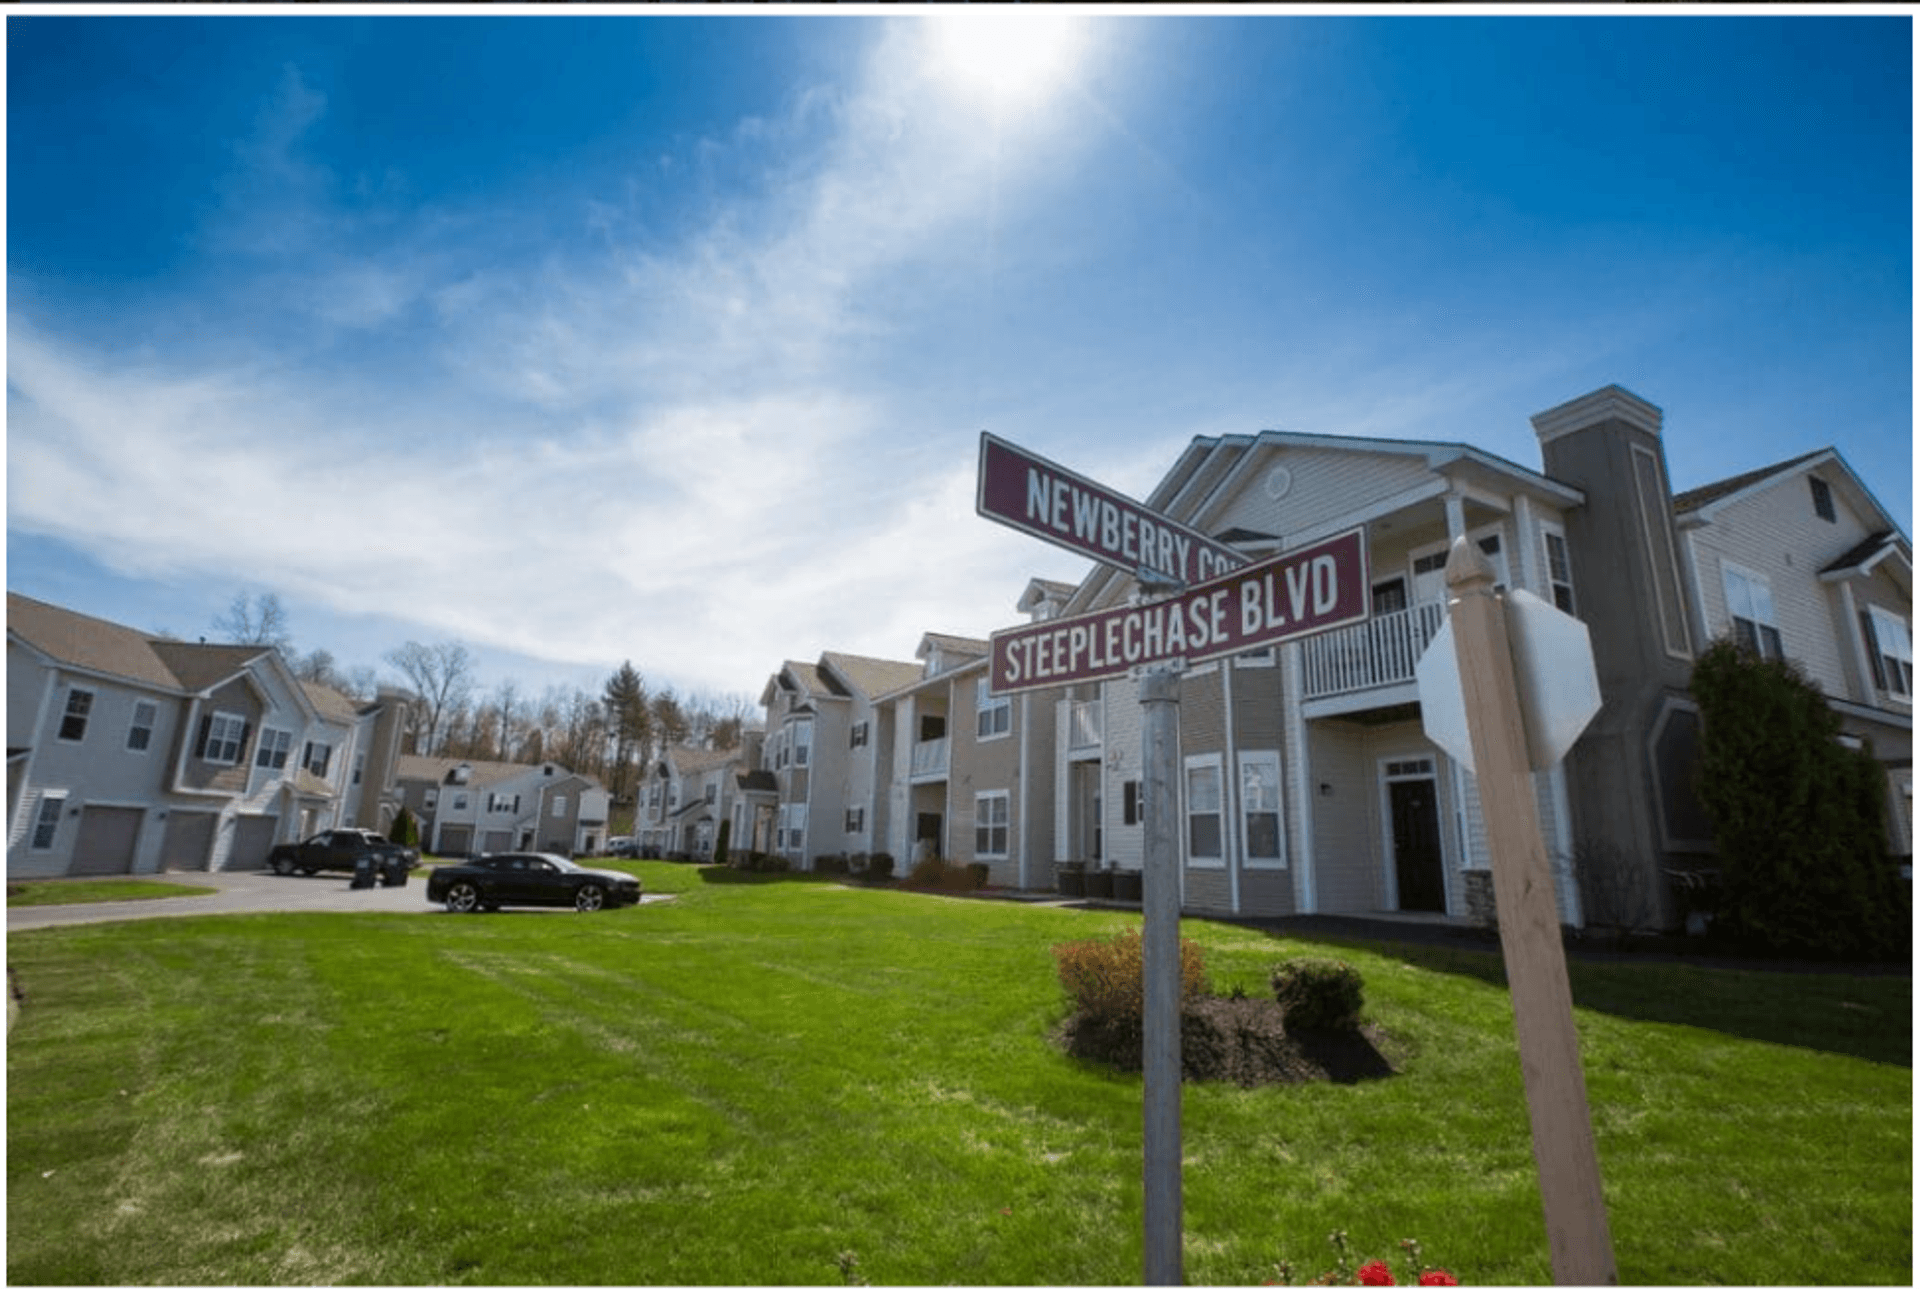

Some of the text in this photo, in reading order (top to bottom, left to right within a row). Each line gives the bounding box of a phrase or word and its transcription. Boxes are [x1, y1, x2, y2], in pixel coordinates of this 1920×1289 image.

[1026, 467, 1190, 582] NEWBERRY
[1005, 554, 1338, 683] STEEPLECHASE BLVD
